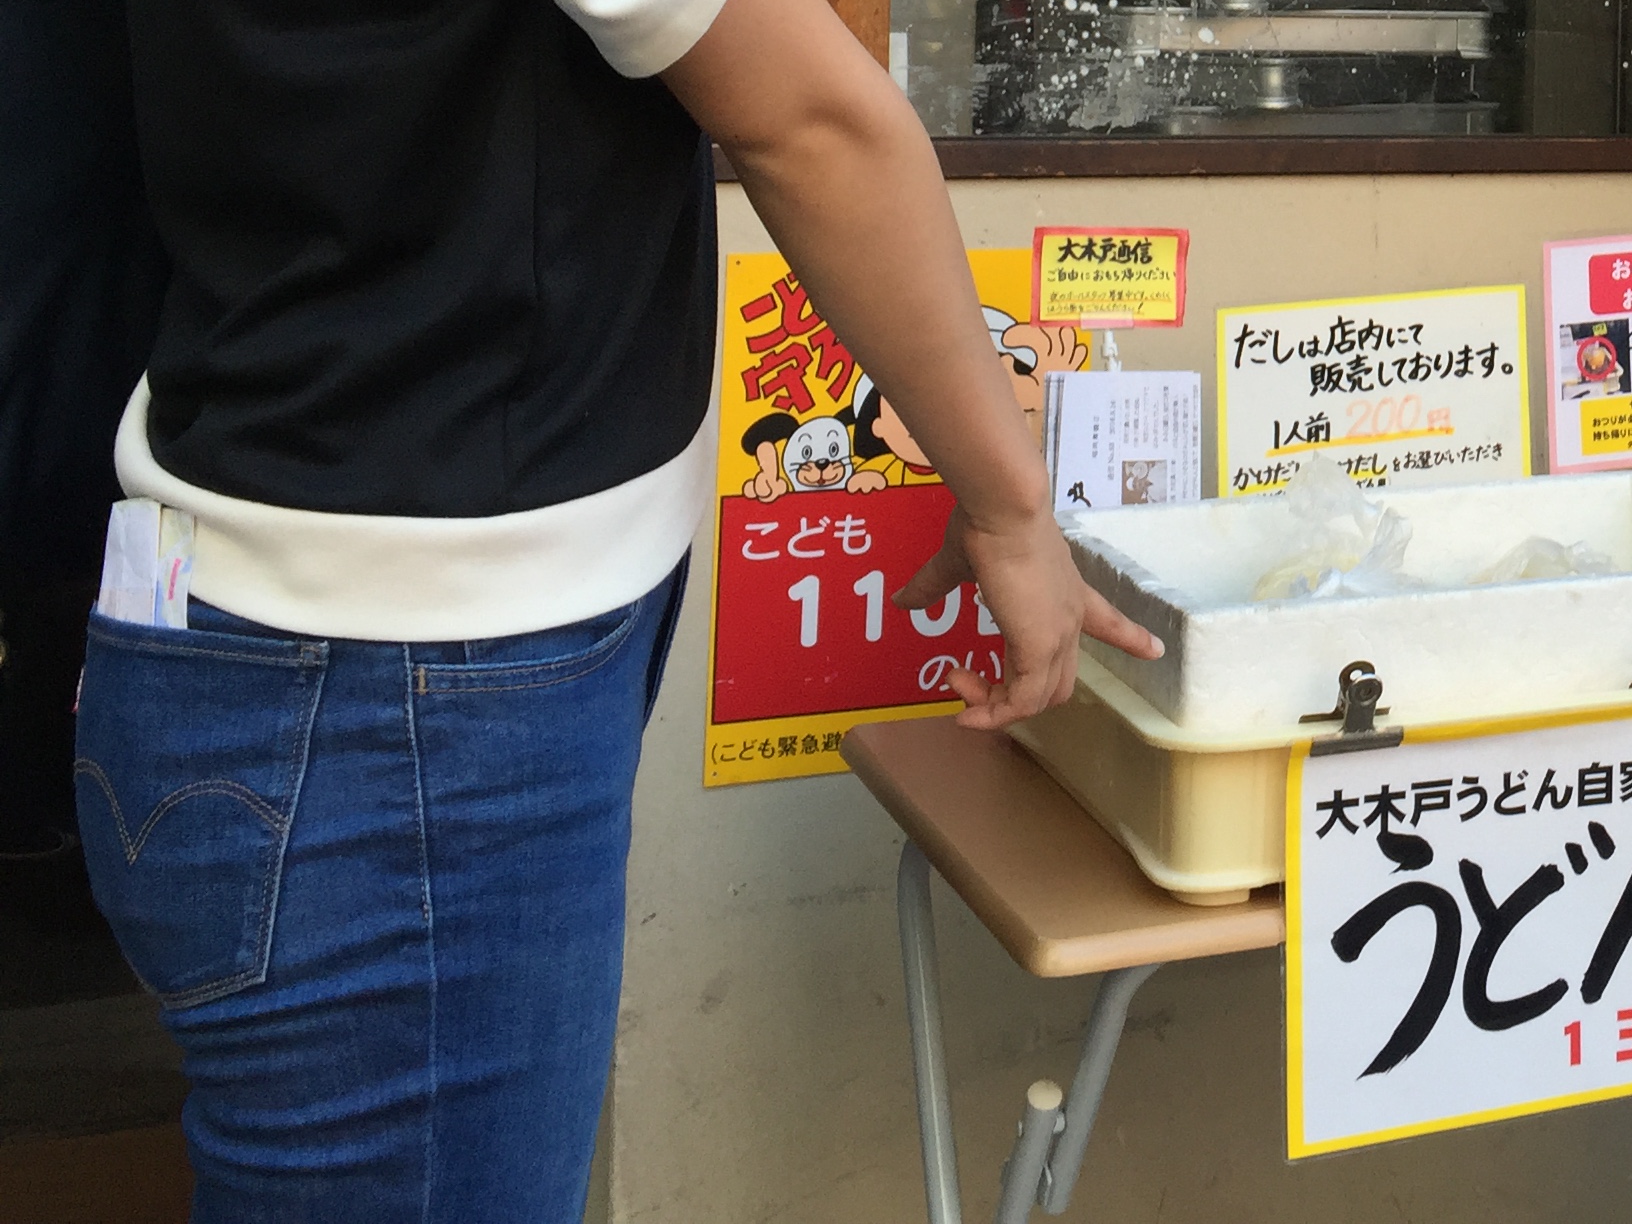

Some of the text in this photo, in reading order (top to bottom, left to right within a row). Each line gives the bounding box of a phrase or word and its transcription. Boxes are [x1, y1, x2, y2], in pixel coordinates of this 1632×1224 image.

[1232, 315, 1425, 370] だしは店内にて
[1310, 341, 1515, 397] 販売しております。
[1273, 411, 1332, 450] 1人前
[741, 513, 872, 560] こども
